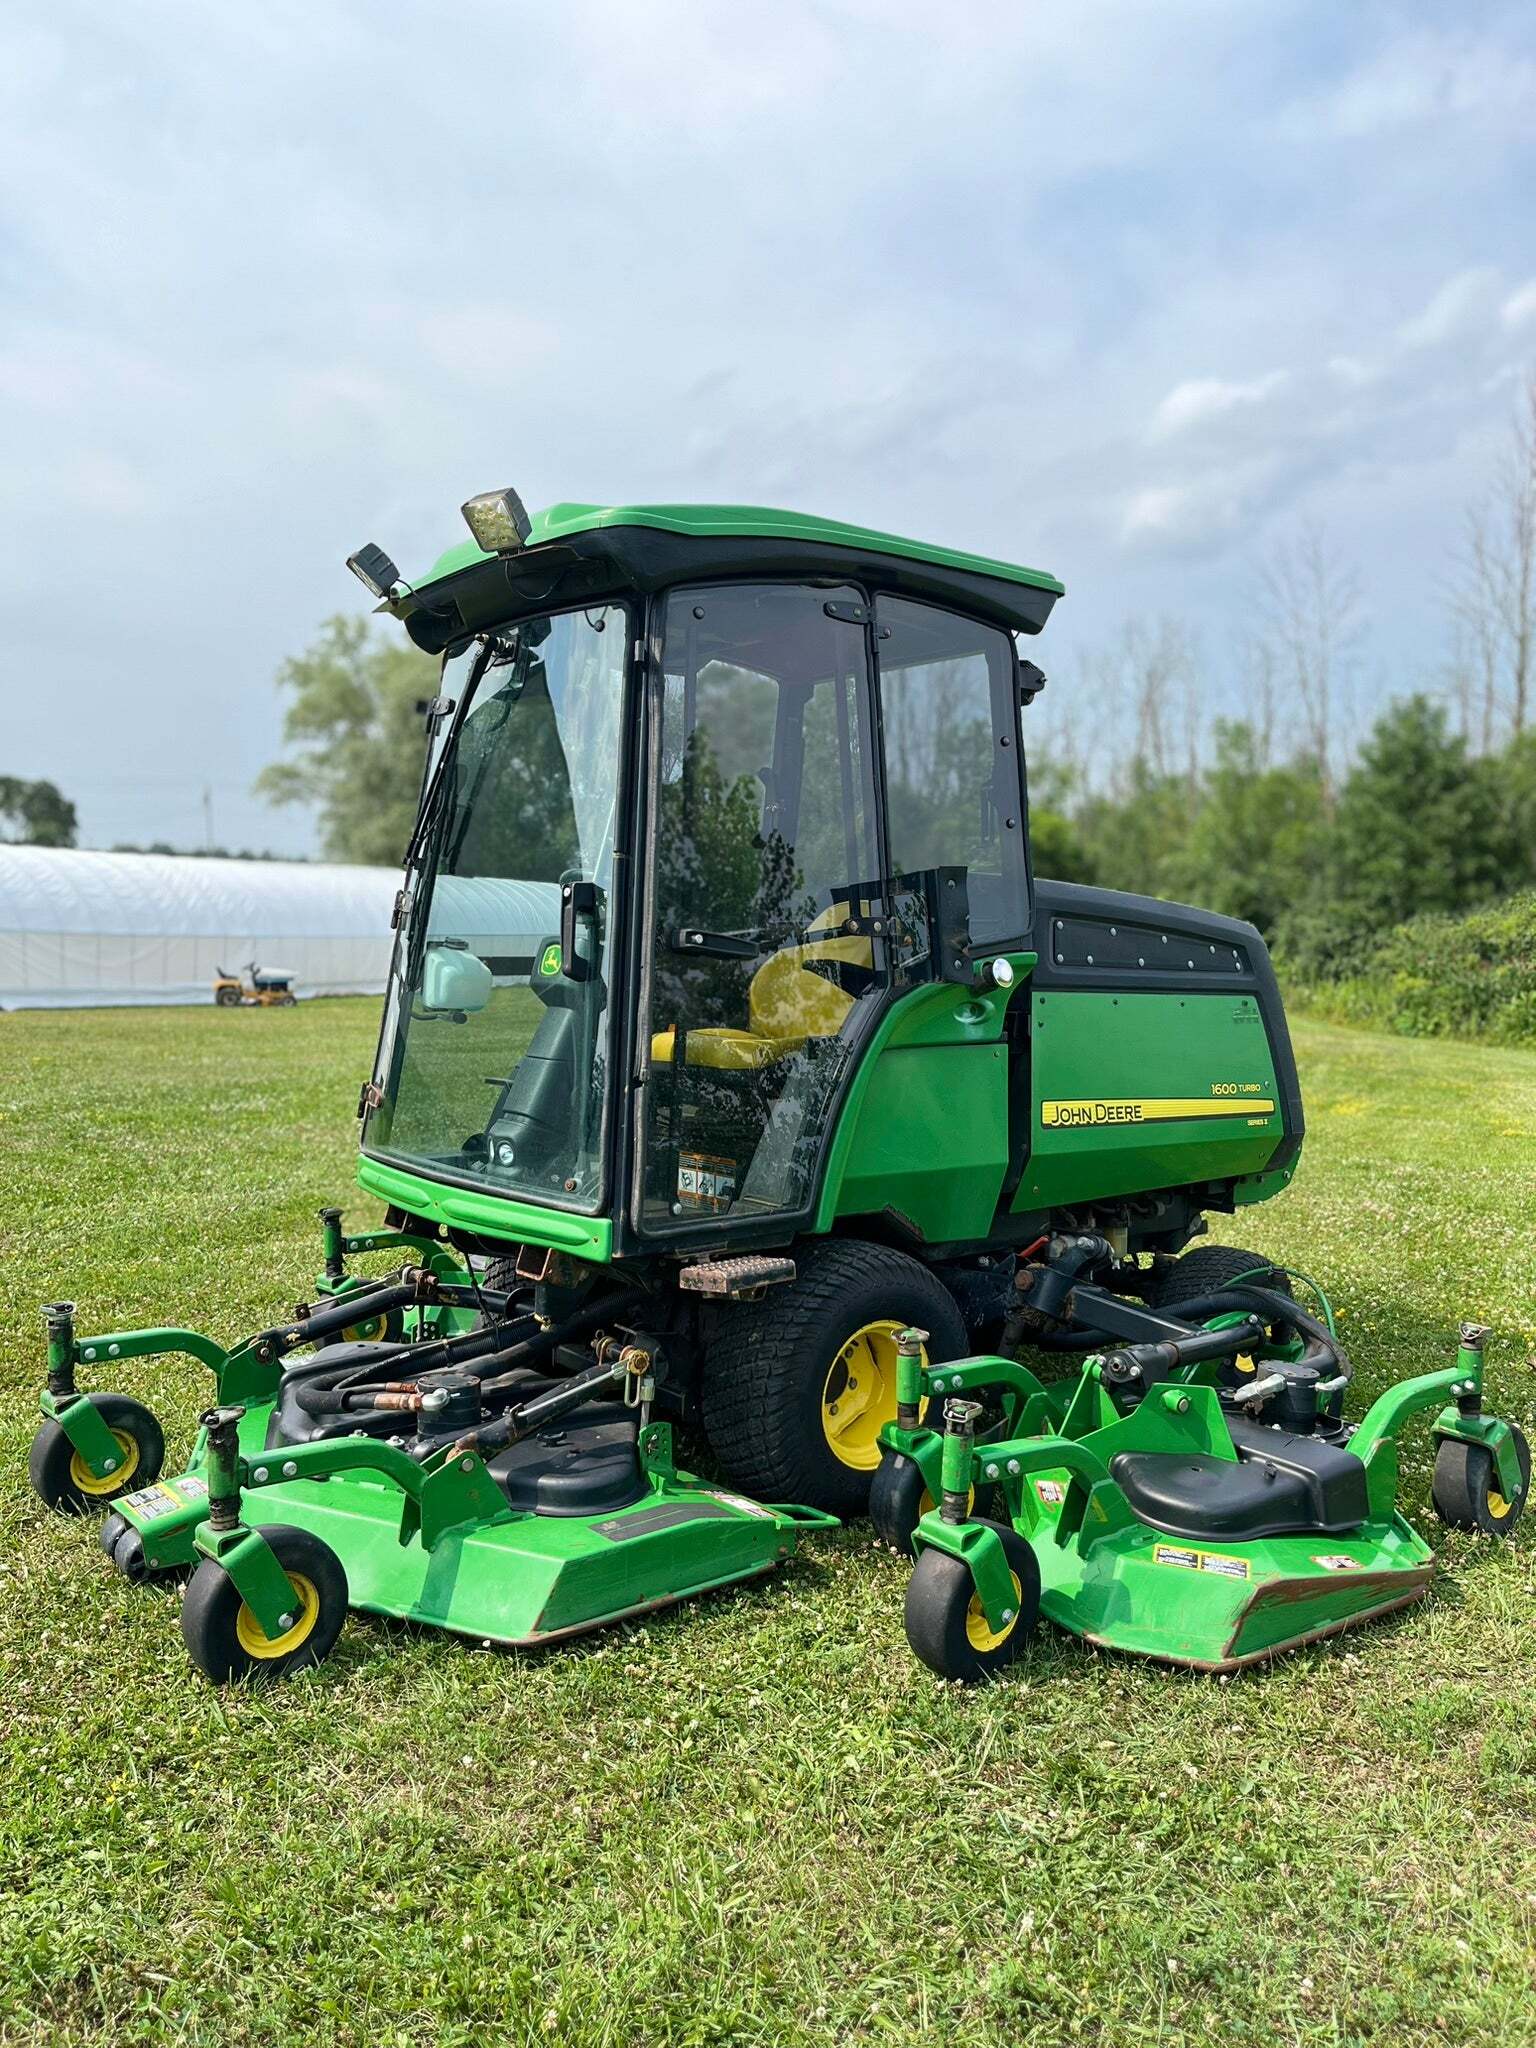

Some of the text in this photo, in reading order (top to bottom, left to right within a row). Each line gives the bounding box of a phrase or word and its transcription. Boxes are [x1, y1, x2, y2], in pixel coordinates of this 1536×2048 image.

[1211, 1083, 1261, 1095] 1600 TURBO
[1051, 1104, 1143, 1124] JOHN DEERE
